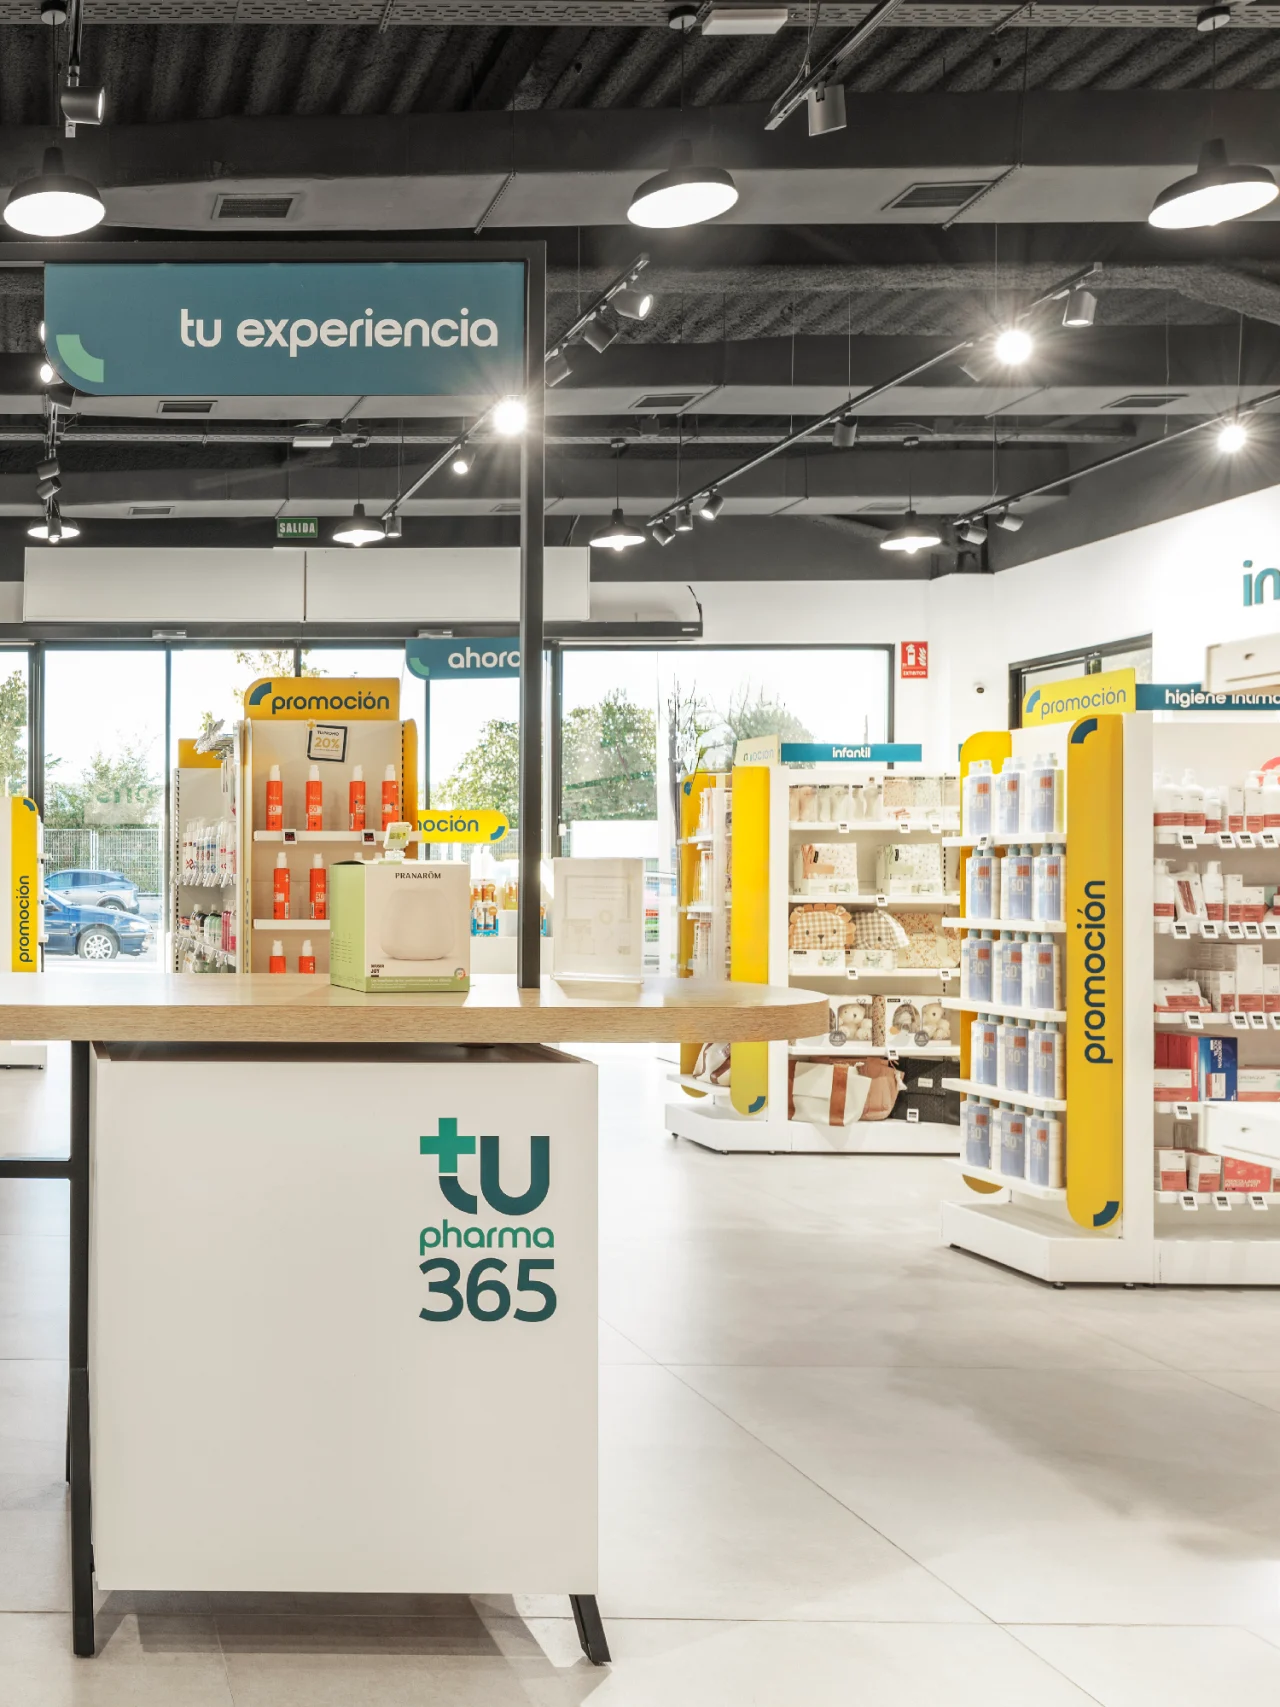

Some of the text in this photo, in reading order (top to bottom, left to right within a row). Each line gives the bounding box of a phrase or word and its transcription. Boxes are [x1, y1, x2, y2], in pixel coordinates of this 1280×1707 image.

[180, 307, 498, 357] tu experiencia
[279, 522, 316, 533] SALIDA
[272, 691, 390, 715] promoción
[1041, 686, 1127, 720] promoción
[1165, 689, 1227, 708] higiene
[315, 736, 340, 749] 20%
[832, 745, 871, 759] infantil
[395, 870, 441, 879] PRANARÔM
[16, 875, 33, 963] promoción
[1077, 880, 1113, 1064] promoción
[419, 1117, 550, 1216] tu
[419, 1218, 554, 1256] pharma
[418, 1257, 557, 1322] 365
